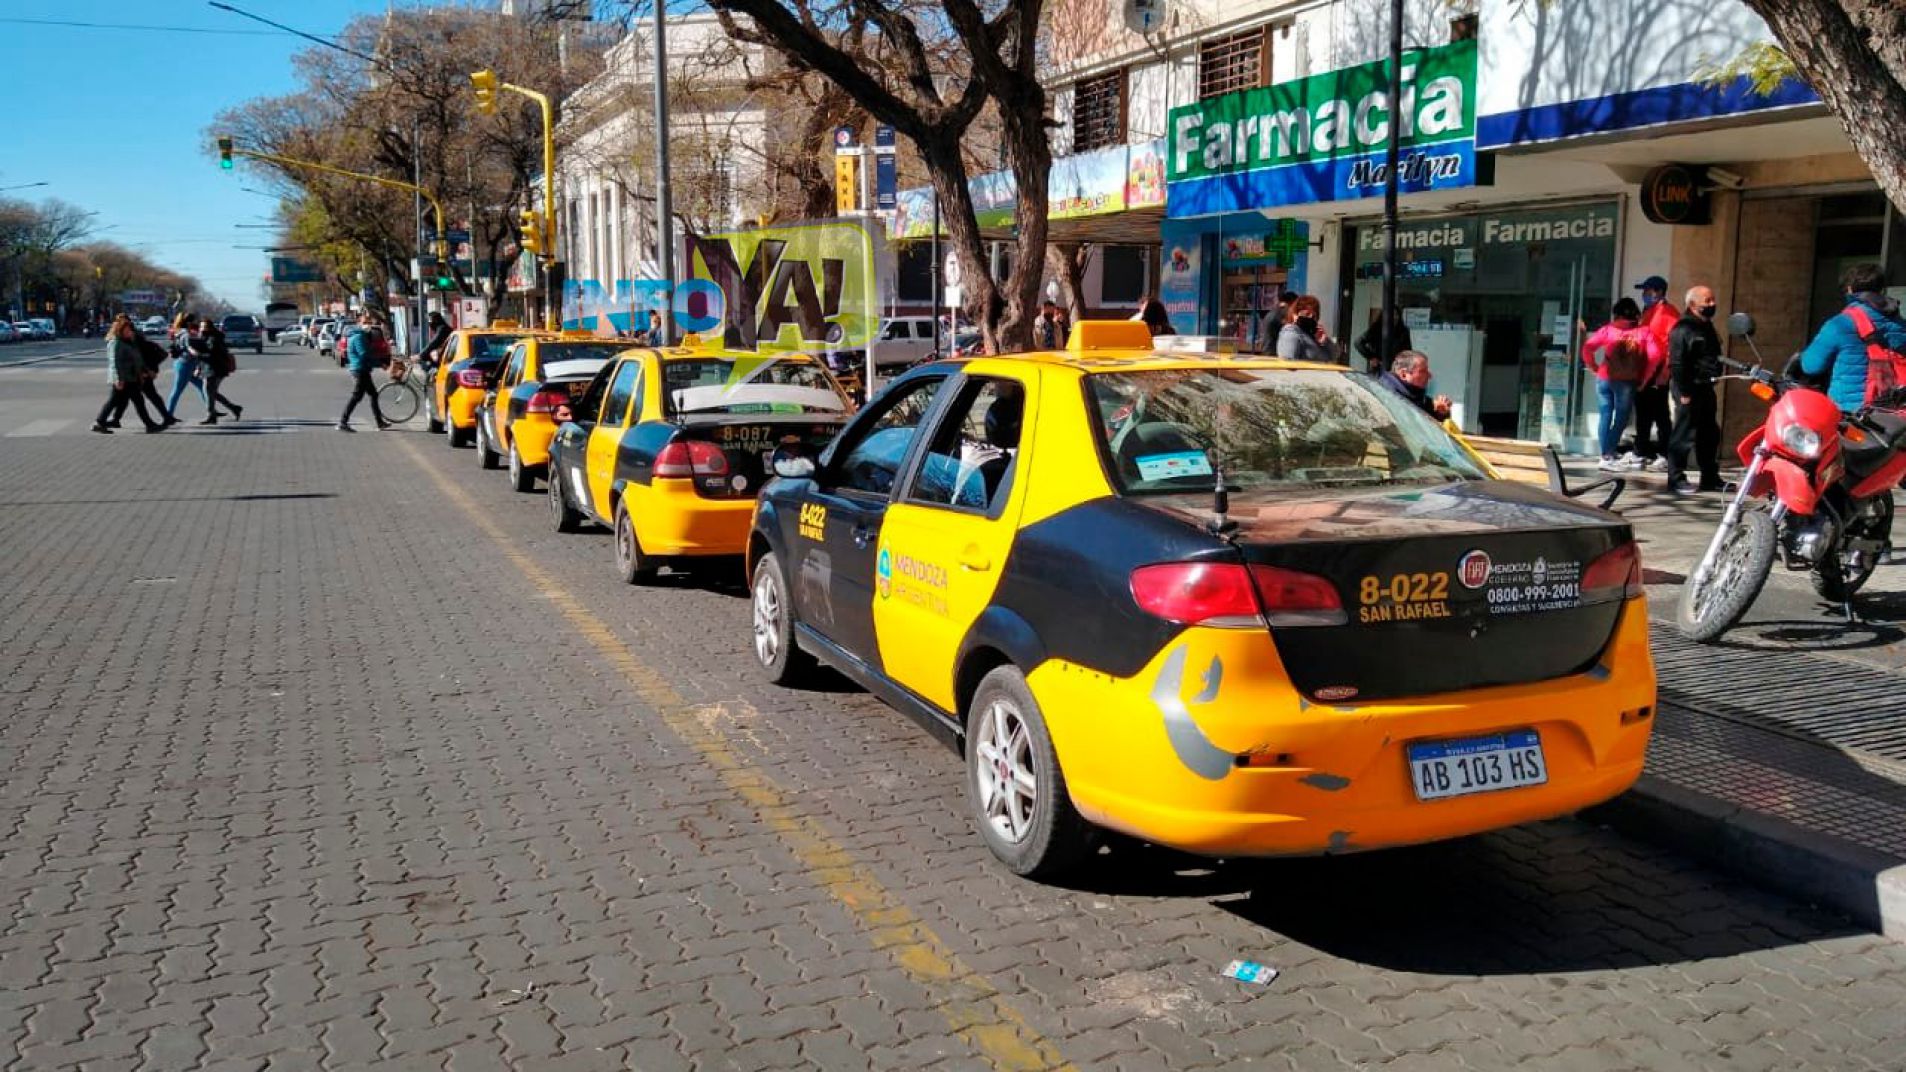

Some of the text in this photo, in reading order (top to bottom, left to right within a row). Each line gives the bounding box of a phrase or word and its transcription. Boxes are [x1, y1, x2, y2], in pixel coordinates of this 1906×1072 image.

[1174, 63, 1464, 175] Farmacia
[1360, 211, 1615, 250] Famacia Farmacia
[894, 553, 949, 588] MENDOZA
[1360, 571, 1449, 605] 8-022
[1487, 582, 1580, 604] 0800-999-2001
[1360, 601, 1451, 622] SAN RAFAEL
[1421, 749, 1541, 793] AB 103 HS
